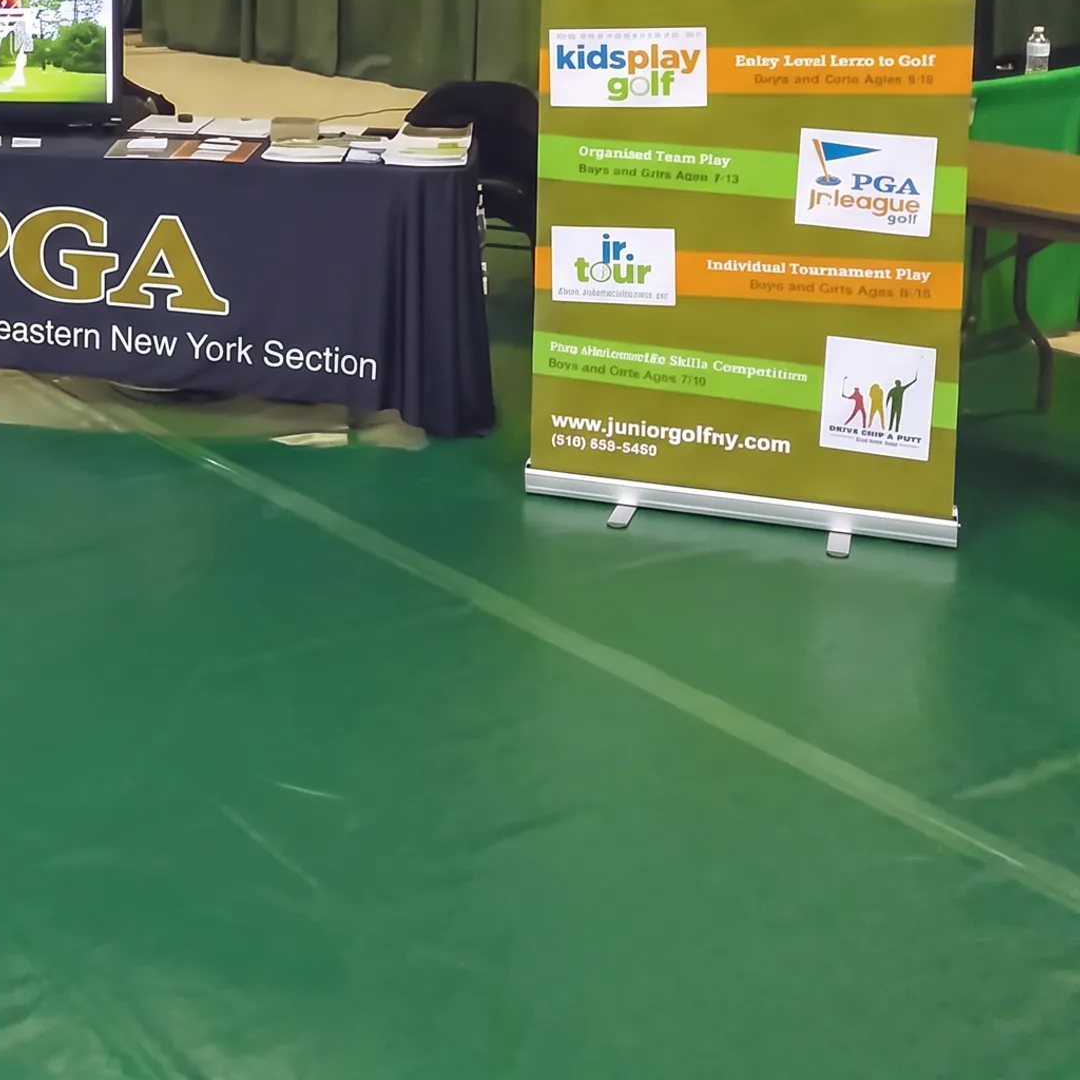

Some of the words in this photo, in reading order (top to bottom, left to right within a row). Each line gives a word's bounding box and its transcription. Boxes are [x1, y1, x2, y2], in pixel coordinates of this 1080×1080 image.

[556, 43, 701, 75] kidsplay
[878, 56, 895, 68] to
[898, 54, 937, 68] Golf
[794, 74, 820, 85] and
[655, 151, 696, 164] Team
[698, 153, 731, 168] Play
[613, 167, 637, 177] and
[850, 173, 921, 196] PGA
[887, 214, 918, 225] golf
[574, 257, 652, 285] tour
[706, 259, 787, 274] Individual
[790, 263, 893, 280] Tournament
[896, 268, 931, 284] Play
[788, 281, 815, 293] and
[110, 325, 178, 358] New
[186, 331, 254, 366] York
[263, 339, 378, 381] Section
[581, 364, 606, 375] and
[551, 414, 791, 455] www.juniorgolfny.com
